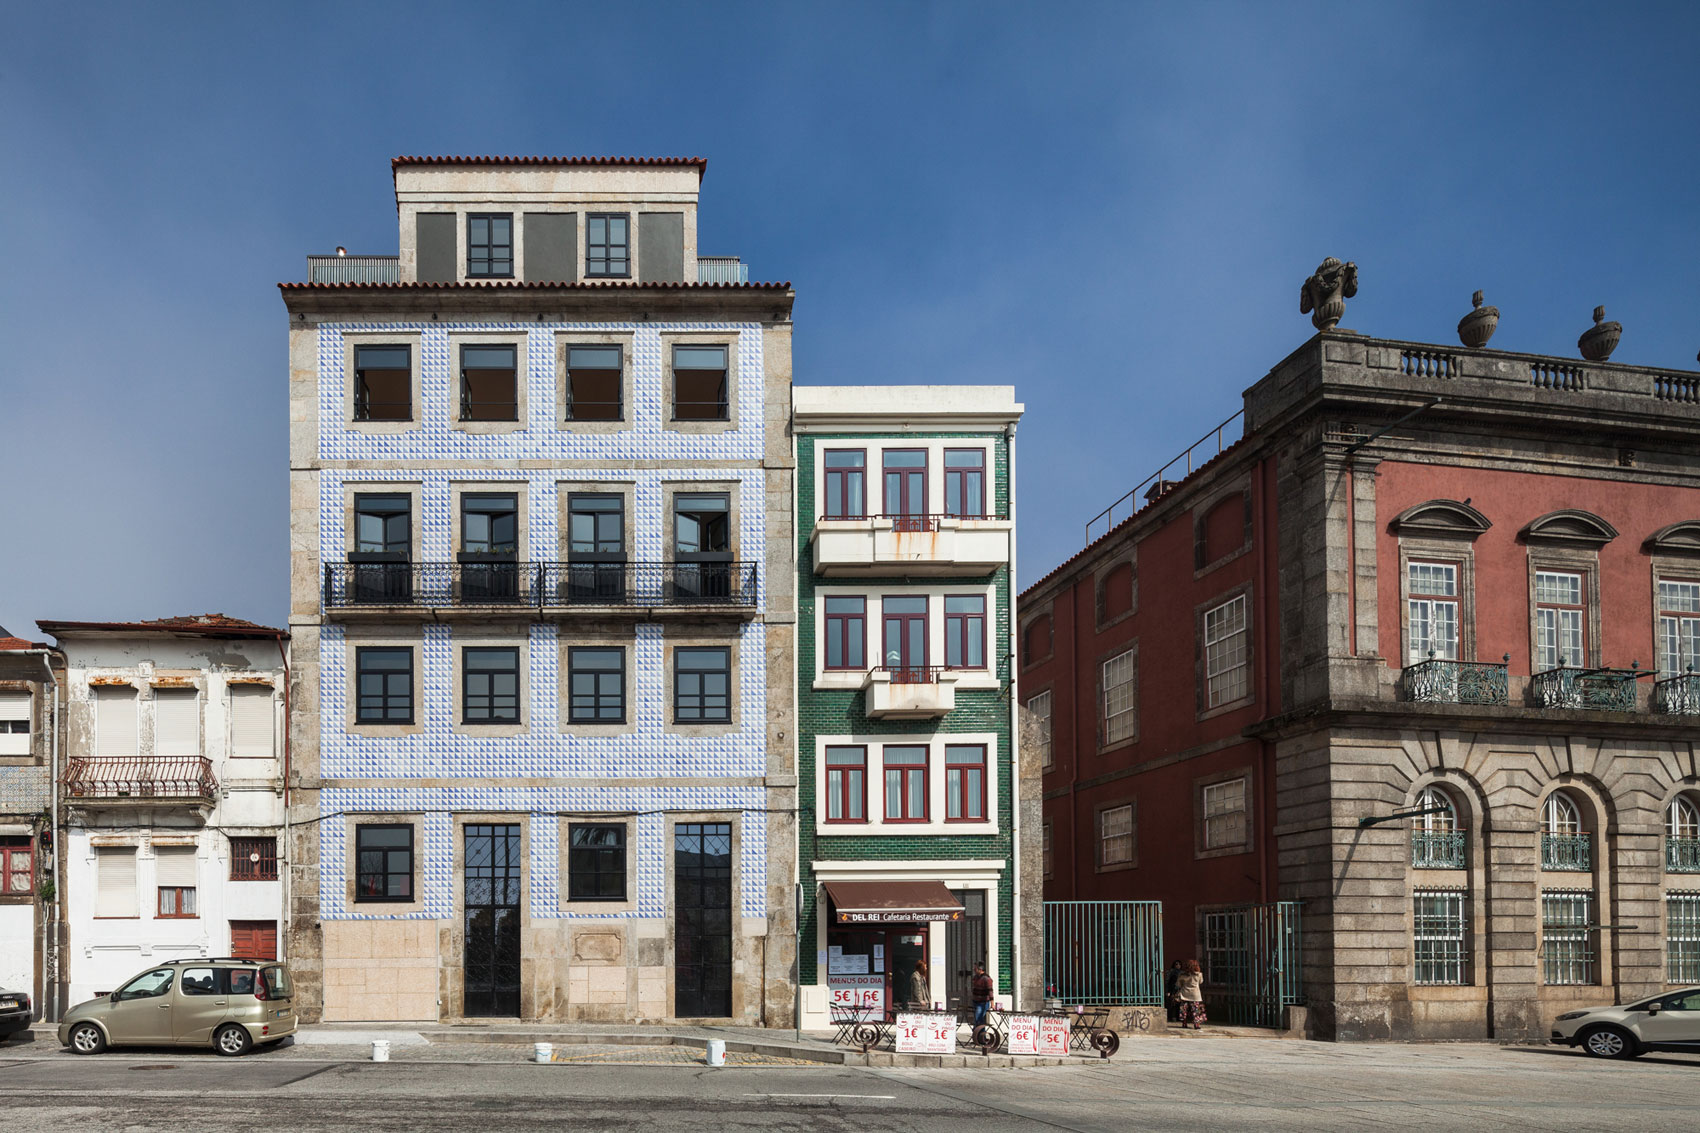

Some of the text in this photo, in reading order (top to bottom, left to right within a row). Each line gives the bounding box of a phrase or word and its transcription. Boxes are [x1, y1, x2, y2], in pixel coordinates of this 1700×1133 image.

[852, 912, 950, 921] DEL REI Cafetaria Restaurante
[834, 990, 851, 1002] 5€
[904, 1027, 918, 1039] 1€
[934, 1029, 948, 1040] 1€
[1053, 1025, 1065, 1033] DIA
[1016, 1031, 1030, 1041] 6€
[1047, 1033, 1060, 1044] 5€
